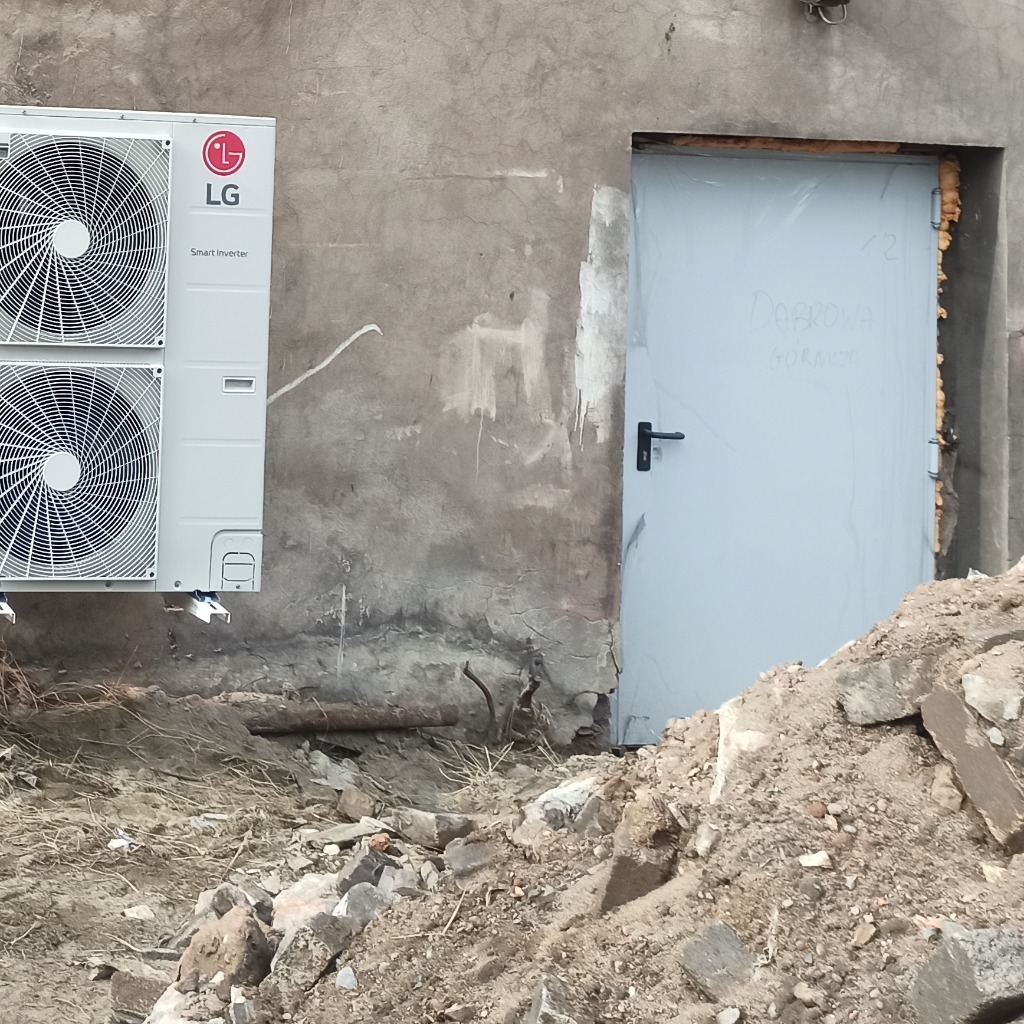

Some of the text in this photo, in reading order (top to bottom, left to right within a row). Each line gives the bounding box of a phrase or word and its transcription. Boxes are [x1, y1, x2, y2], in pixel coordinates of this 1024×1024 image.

[206, 183, 240, 206] LG
[190, 247, 249, 258] Smart Inverter
